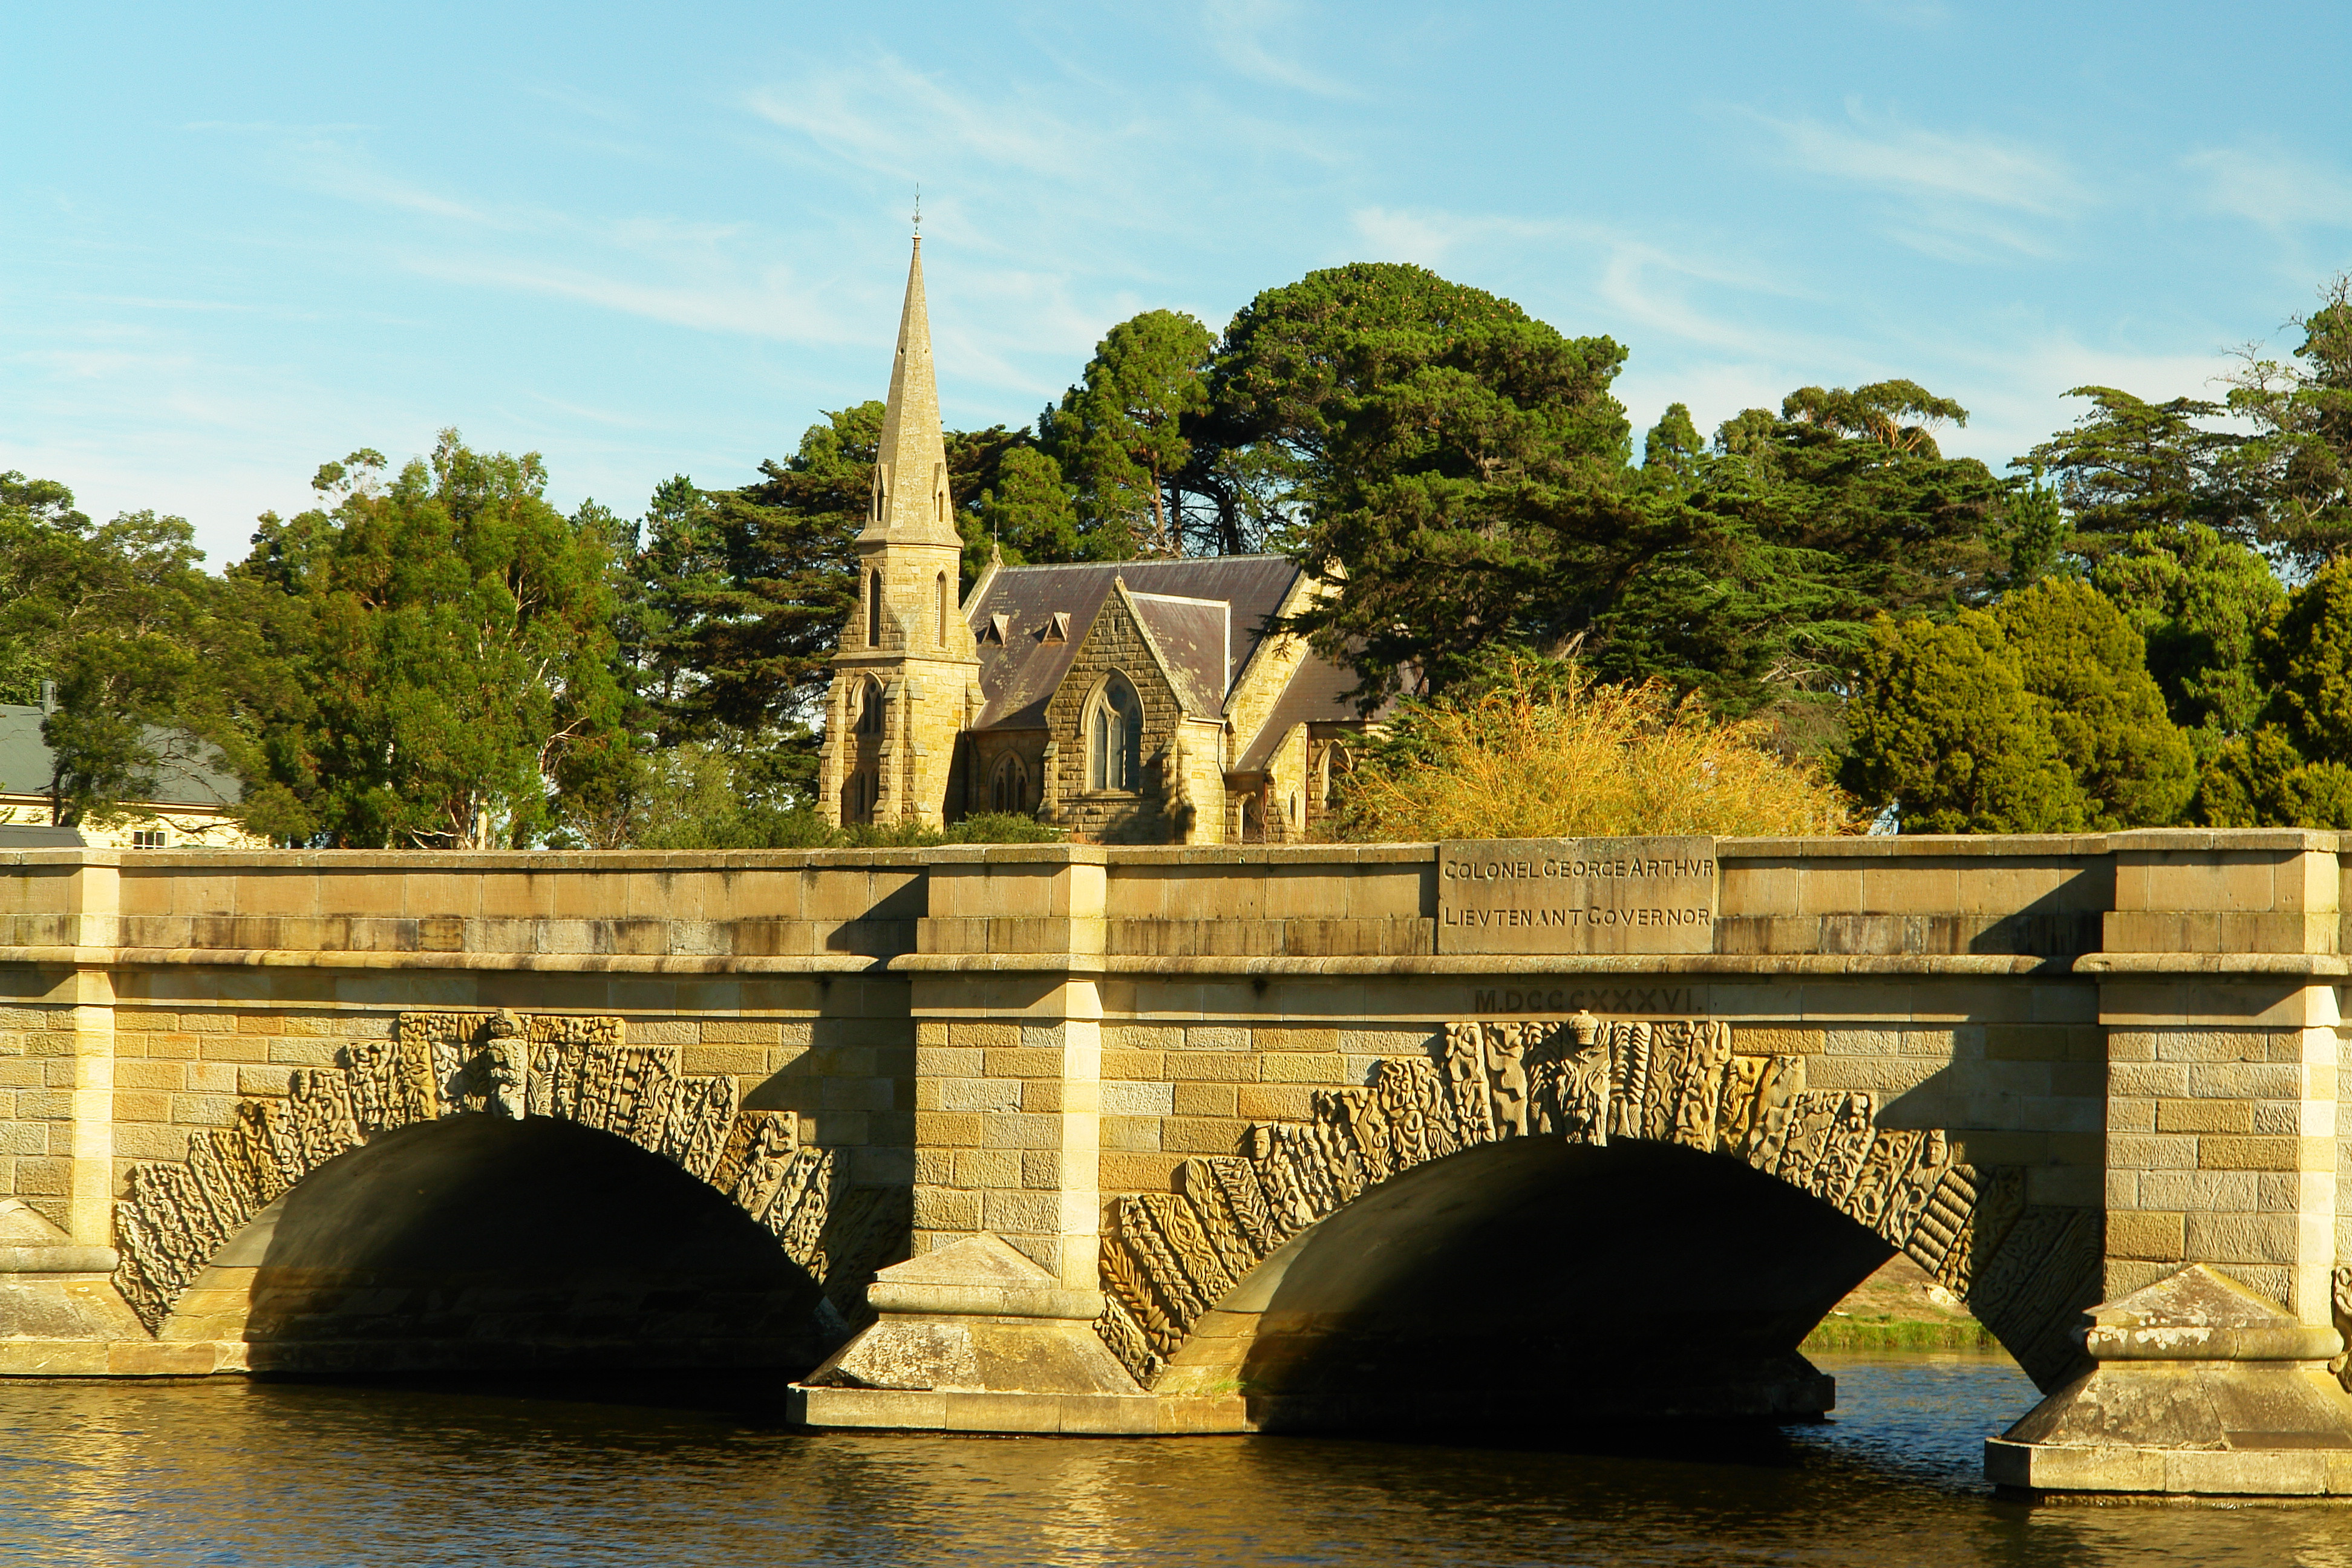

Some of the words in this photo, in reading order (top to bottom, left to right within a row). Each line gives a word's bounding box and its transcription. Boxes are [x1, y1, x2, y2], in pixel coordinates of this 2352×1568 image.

[1443, 860, 1540, 880] COLONEL
[1542, 858, 1625, 879] GEORGE
[1627, 857, 1714, 878] ARTHVR
[1443, 907, 1583, 927] LIEVTENANT
[1587, 906, 1710, 928] GOVERNOR
